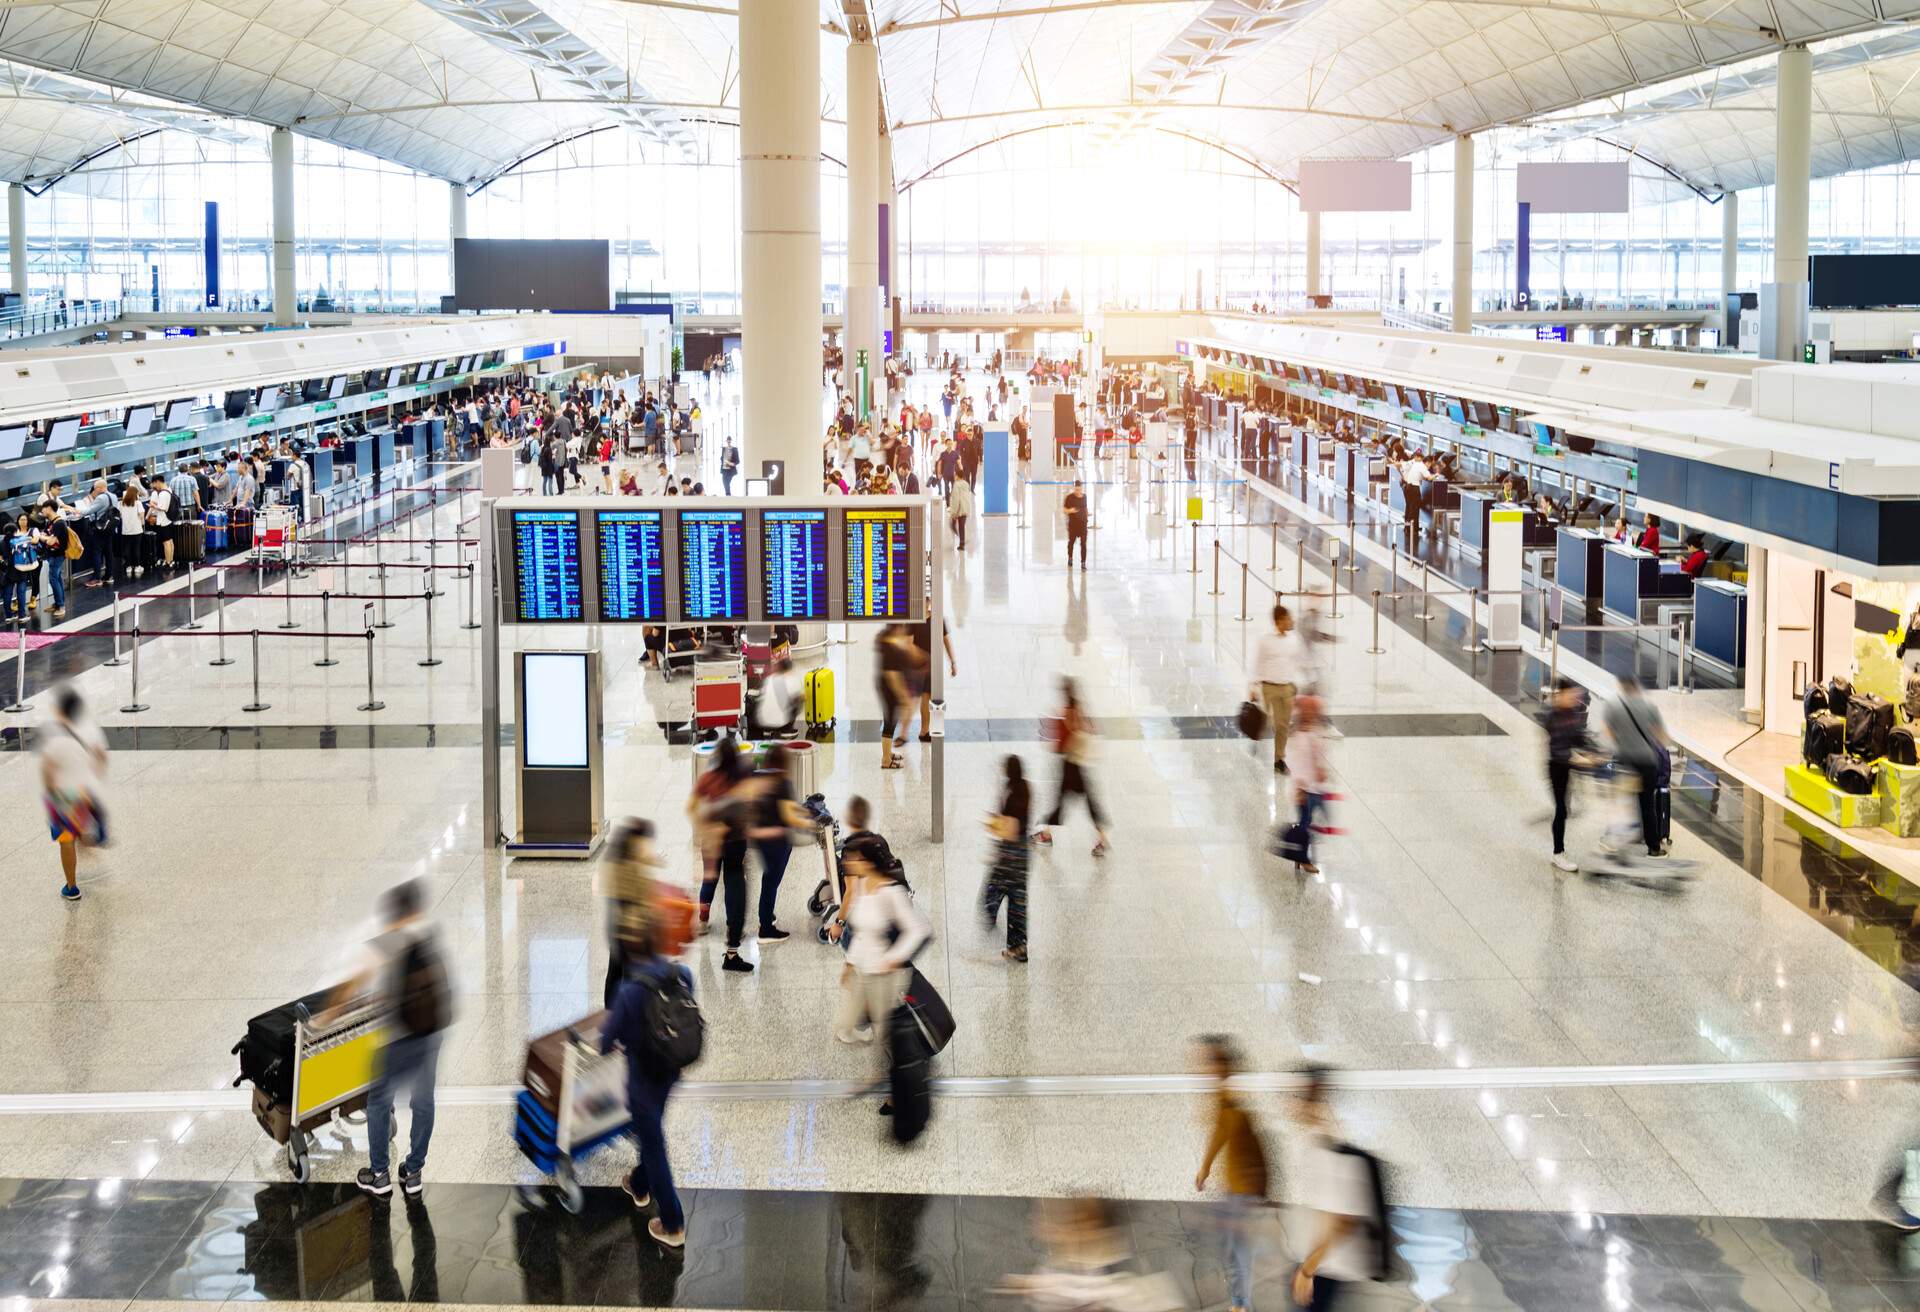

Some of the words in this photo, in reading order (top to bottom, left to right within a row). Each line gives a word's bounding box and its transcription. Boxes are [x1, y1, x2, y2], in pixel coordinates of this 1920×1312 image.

[208, 294, 216, 304] F
[1519, 292, 1527, 303] D
[1829, 462, 1840, 490] E
